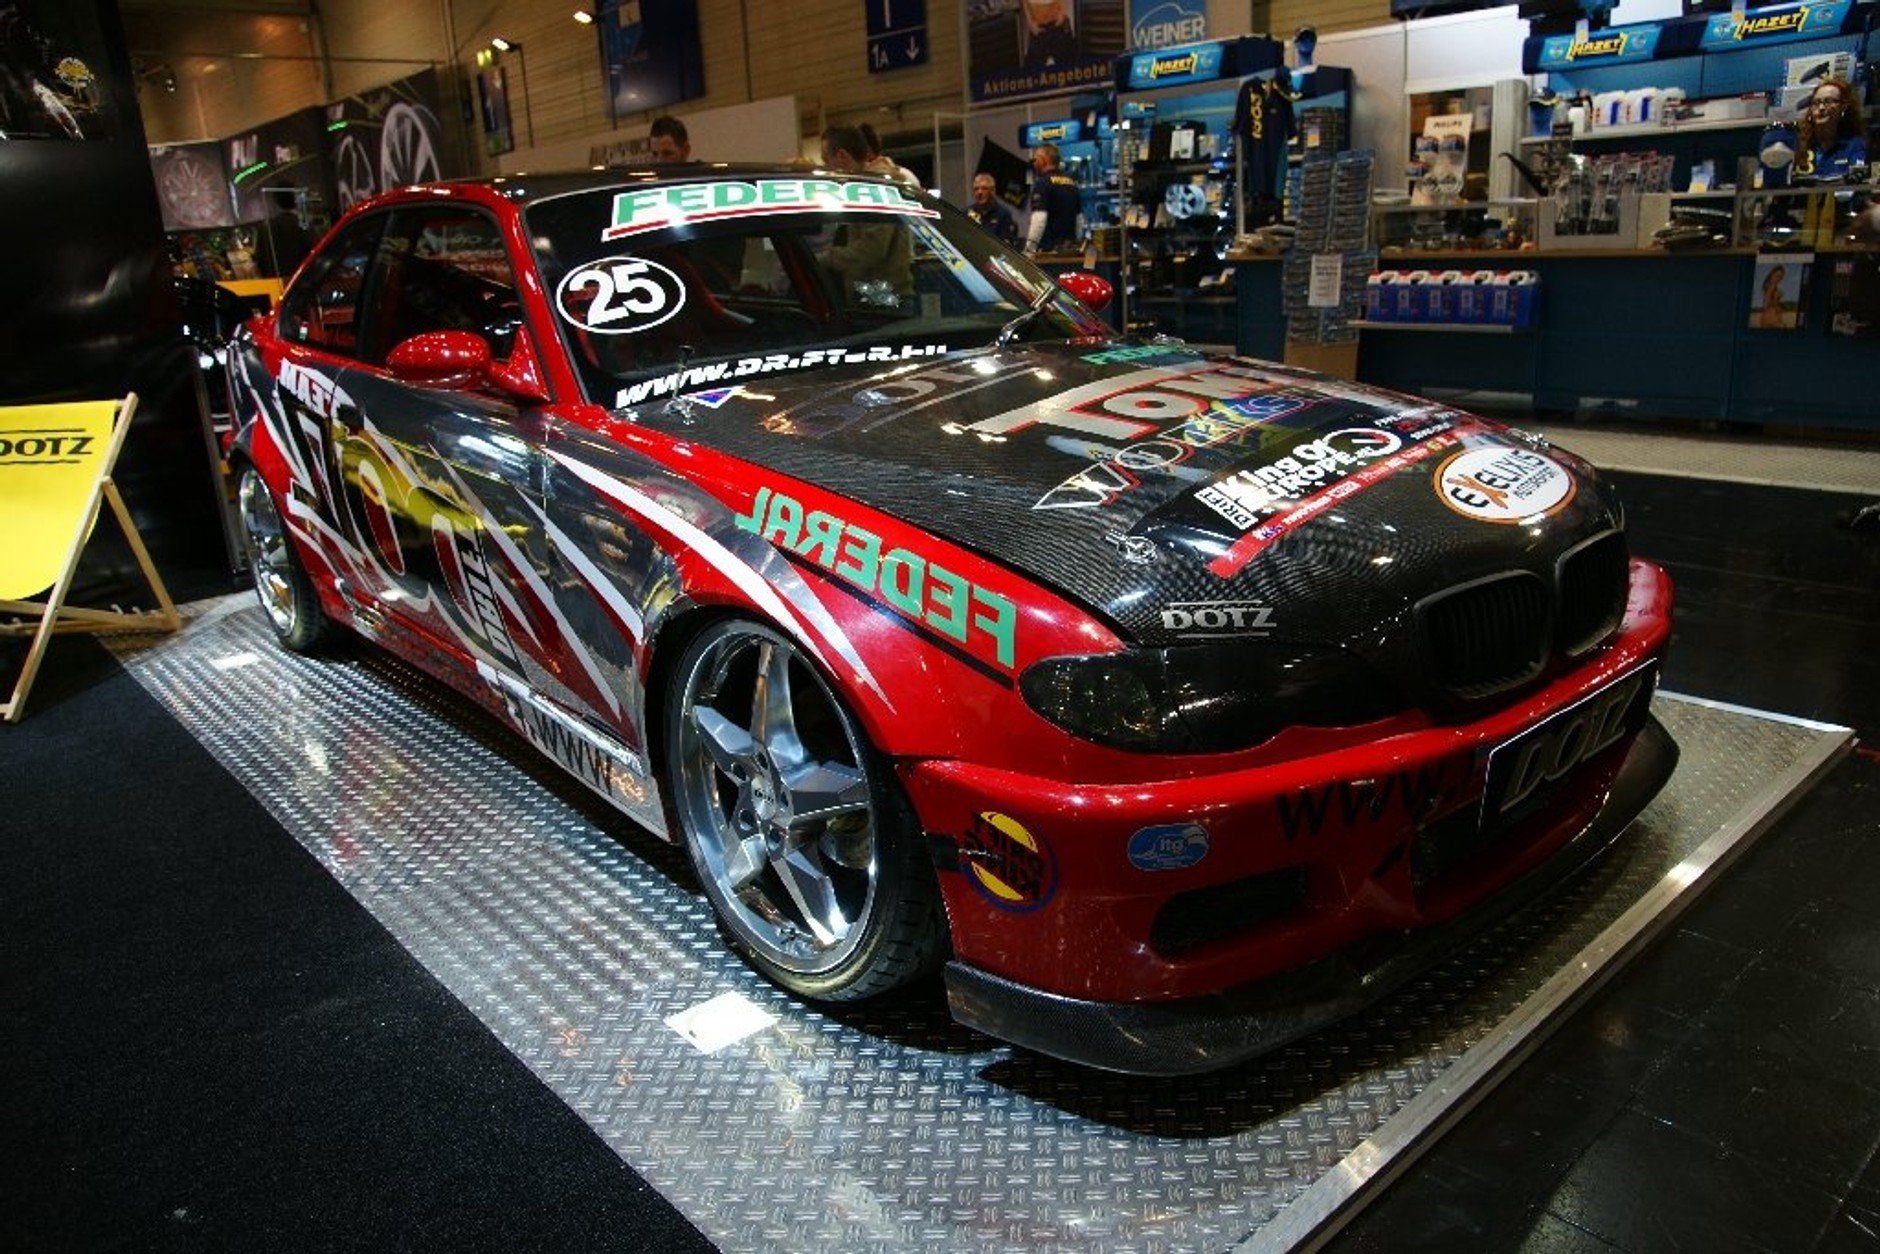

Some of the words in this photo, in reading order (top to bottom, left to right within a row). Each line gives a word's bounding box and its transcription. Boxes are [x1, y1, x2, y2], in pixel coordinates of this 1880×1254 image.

[1133, 15, 1205, 47] WEINER
[1743, 13, 1802, 34] HAZET
[871, 44, 890, 68] 1A
[1571, 37, 1622, 56] HAZET
[613, 180, 923, 226] FEDERAL
[569, 263, 666, 326] 25
[1199, 490, 1251, 526] DRIFT
[1161, 604, 1277, 631] DOTZ
[1500, 670, 1643, 813] DOTZ
